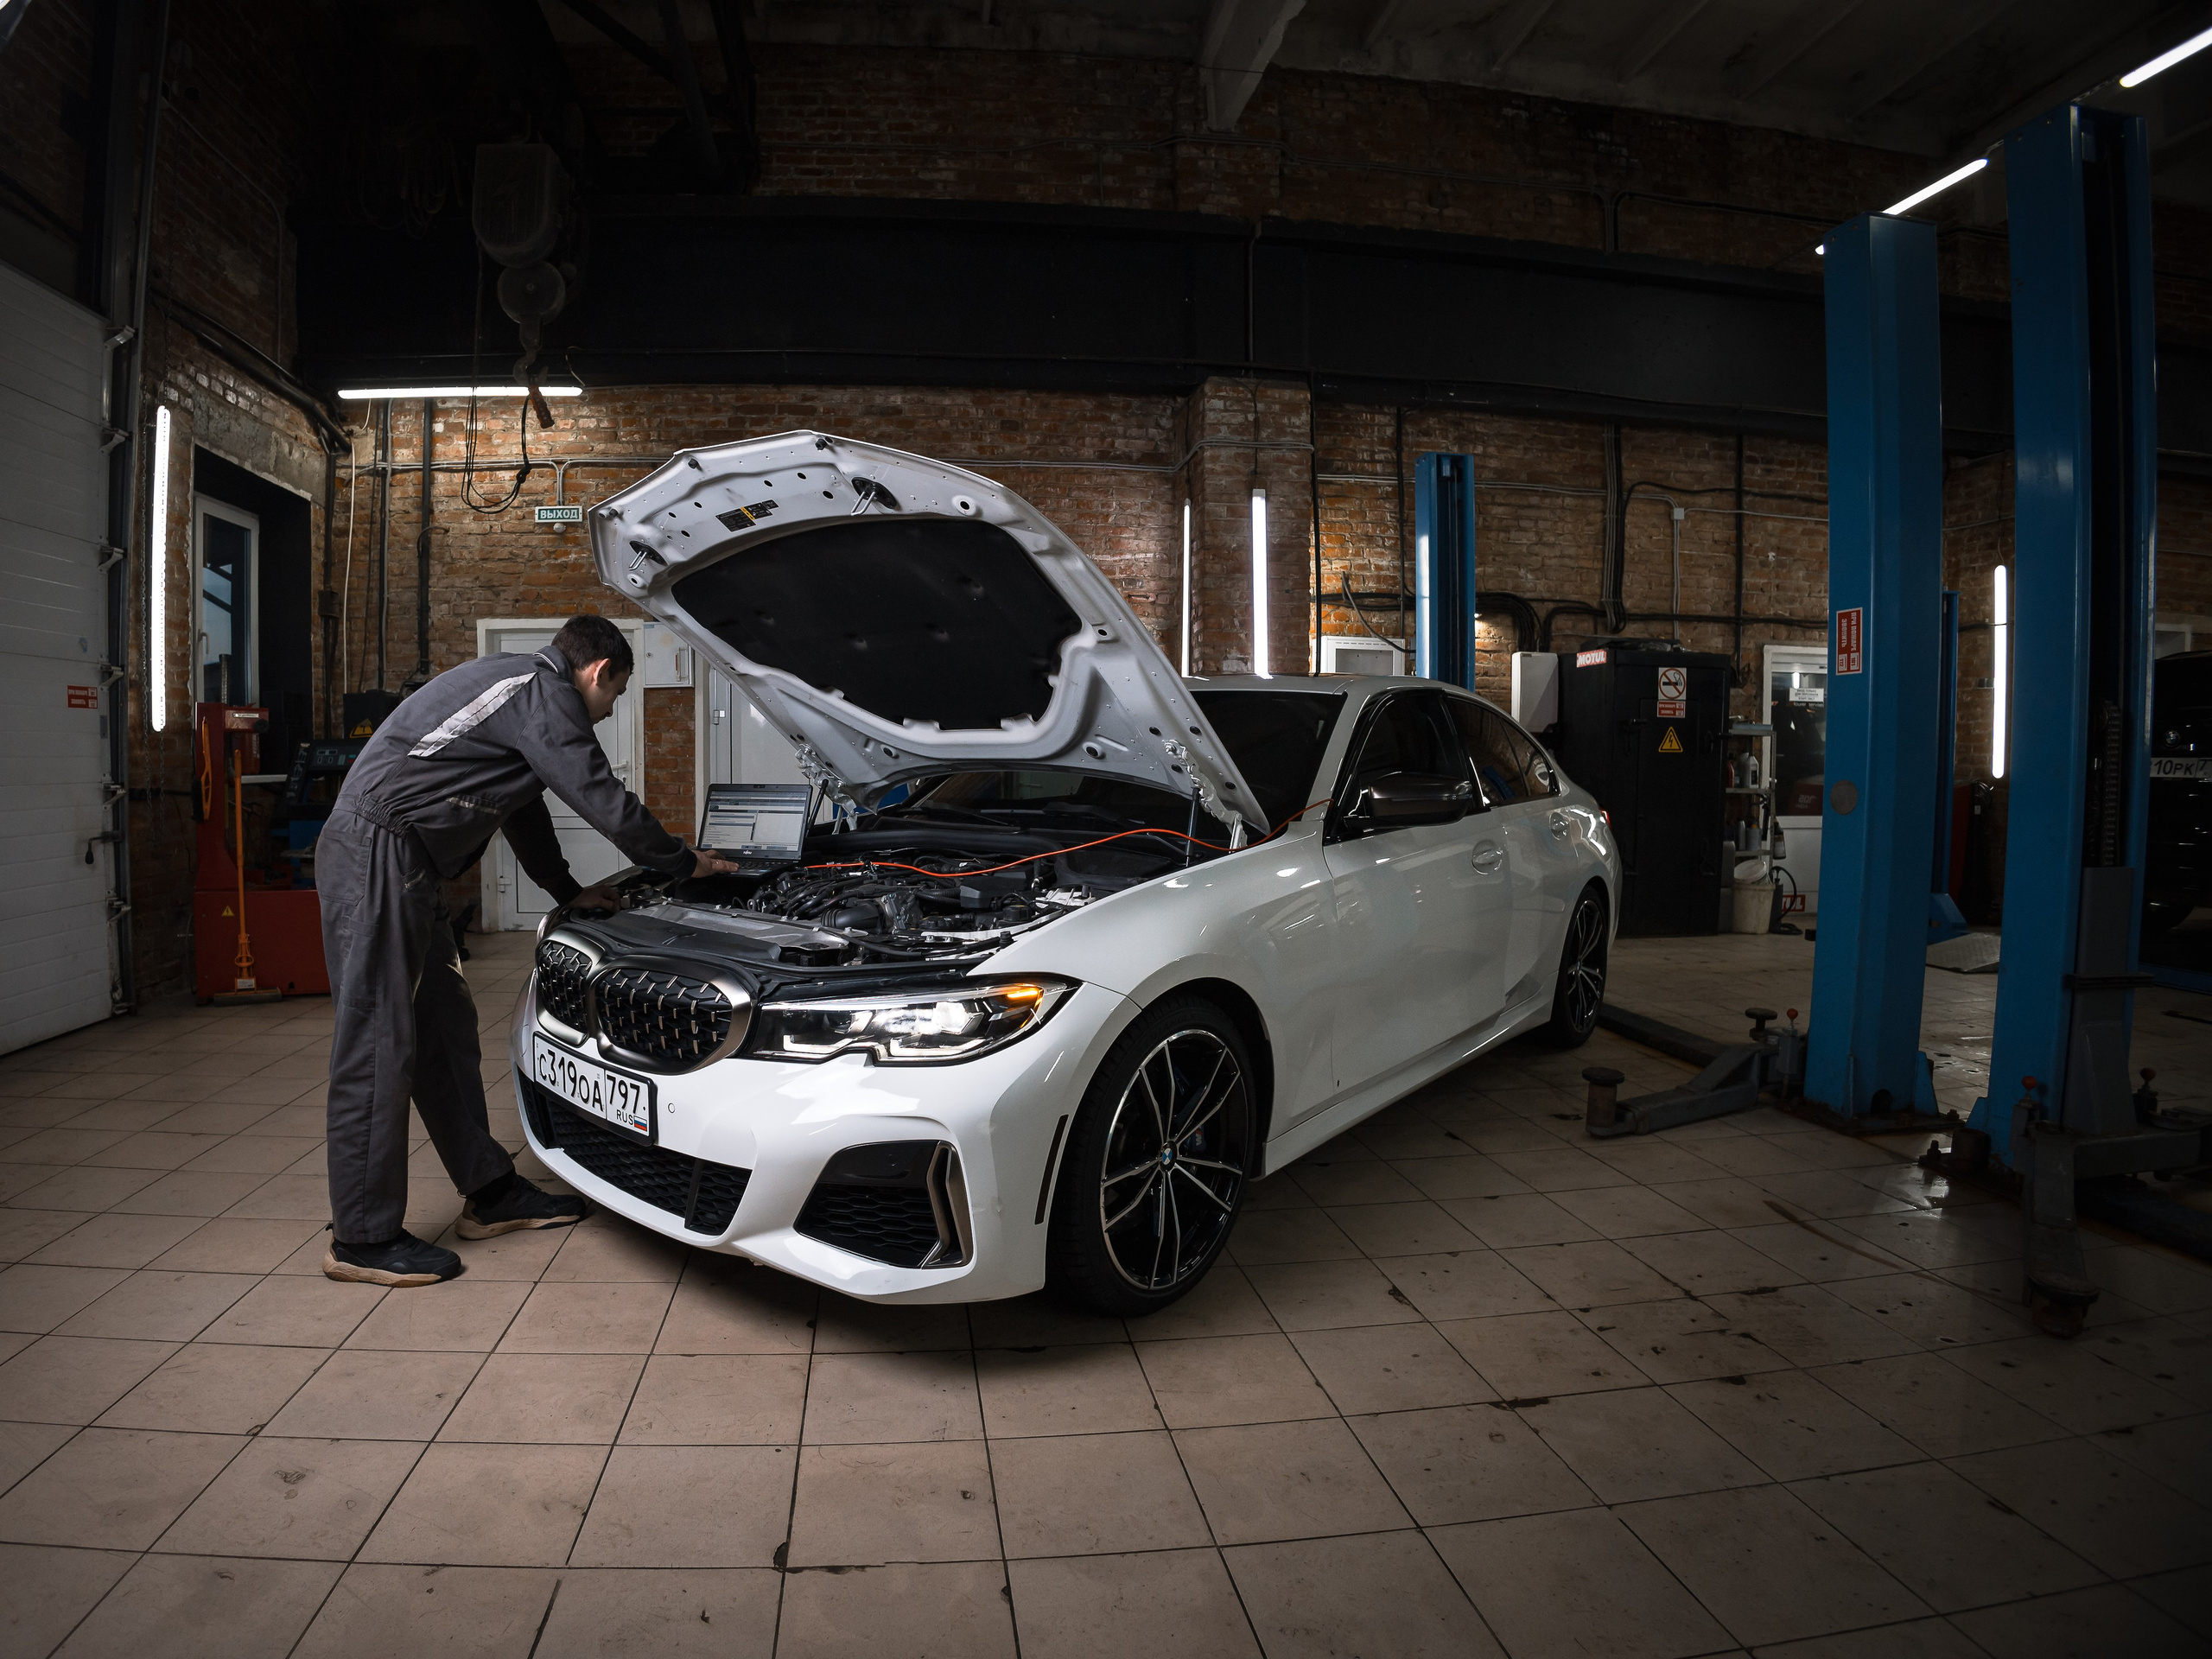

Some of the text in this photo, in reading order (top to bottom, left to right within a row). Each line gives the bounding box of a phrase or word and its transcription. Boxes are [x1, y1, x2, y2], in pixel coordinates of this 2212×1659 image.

[540, 509, 578, 519] ВЫХОД
[1577, 651, 1605, 664] MOTUL
[2150, 759, 2195, 776] 10РК
[539, 1048, 640, 1115] С319ОА 797
[616, 1109, 634, 1126] RUS
